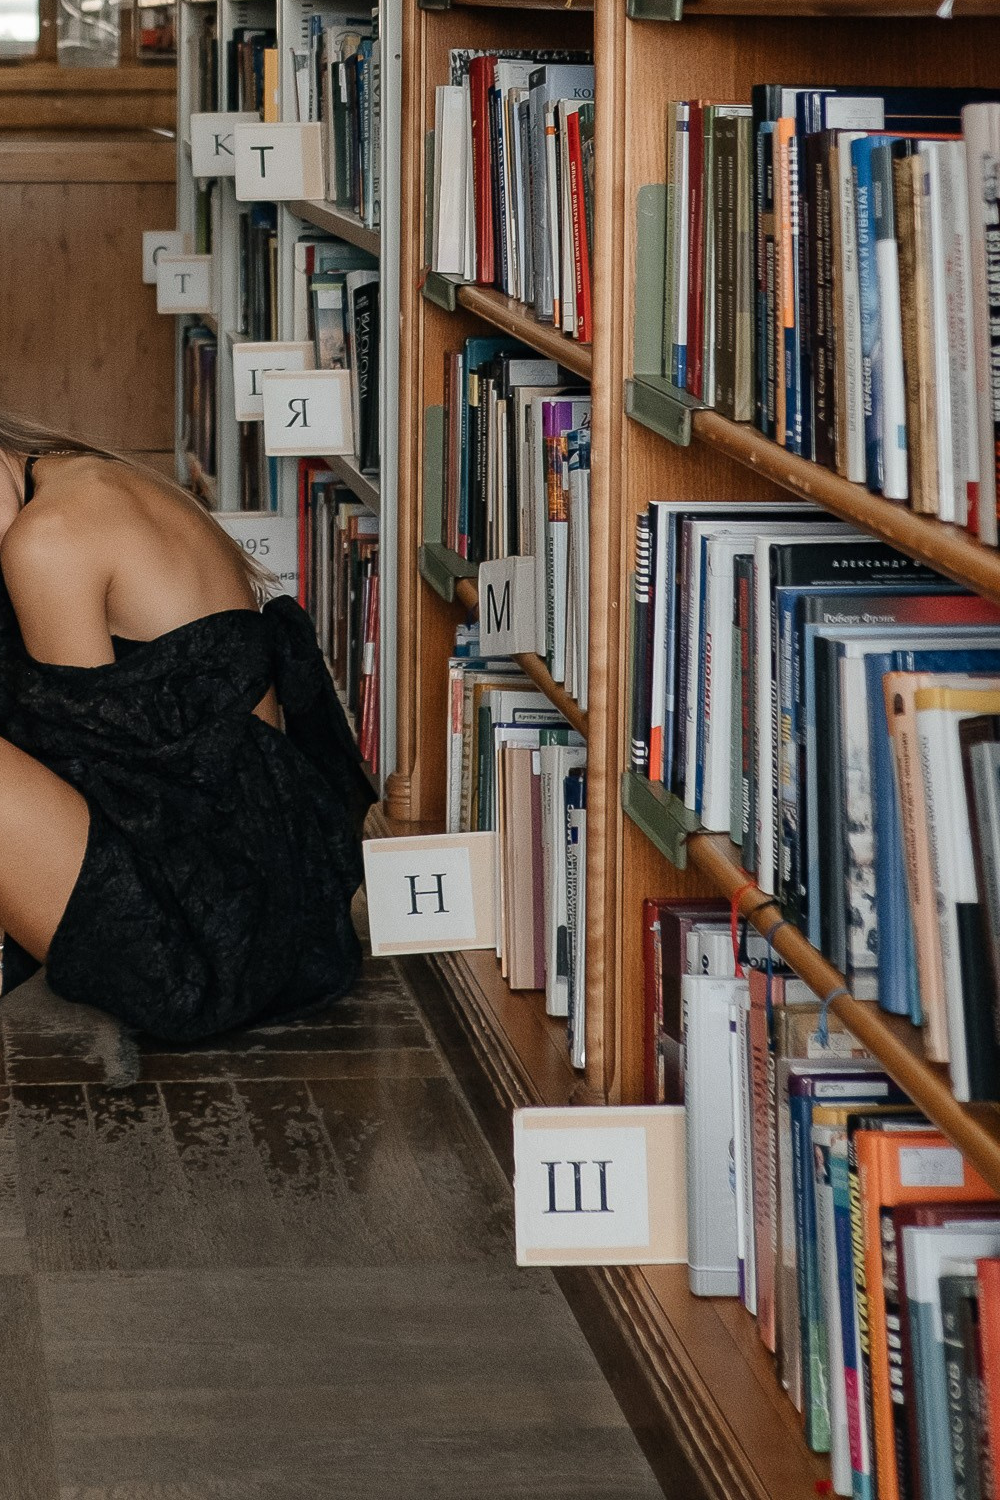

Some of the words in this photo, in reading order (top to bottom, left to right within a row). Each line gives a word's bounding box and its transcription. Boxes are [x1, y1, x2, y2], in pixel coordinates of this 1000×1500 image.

[573, 88, 594, 99] КО
[212, 134, 234, 156] К
[251, 146, 274, 177] Т
[175, 274, 191, 293] Т
[286, 399, 308, 427] Я
[831, 560, 908, 569] АЛЕКСАНДР
[487, 580, 510, 634] М
[704, 632, 713, 720] ГОВОРИТЕ
[405, 874, 448, 915] Н
[542, 1161, 612, 1213] Ш
[768, 1128, 777, 1253] ПСИХОЛОГИЯ
[849, 1172, 867, 1289] RUNNING
[855, 1290, 869, 1354] MAN
